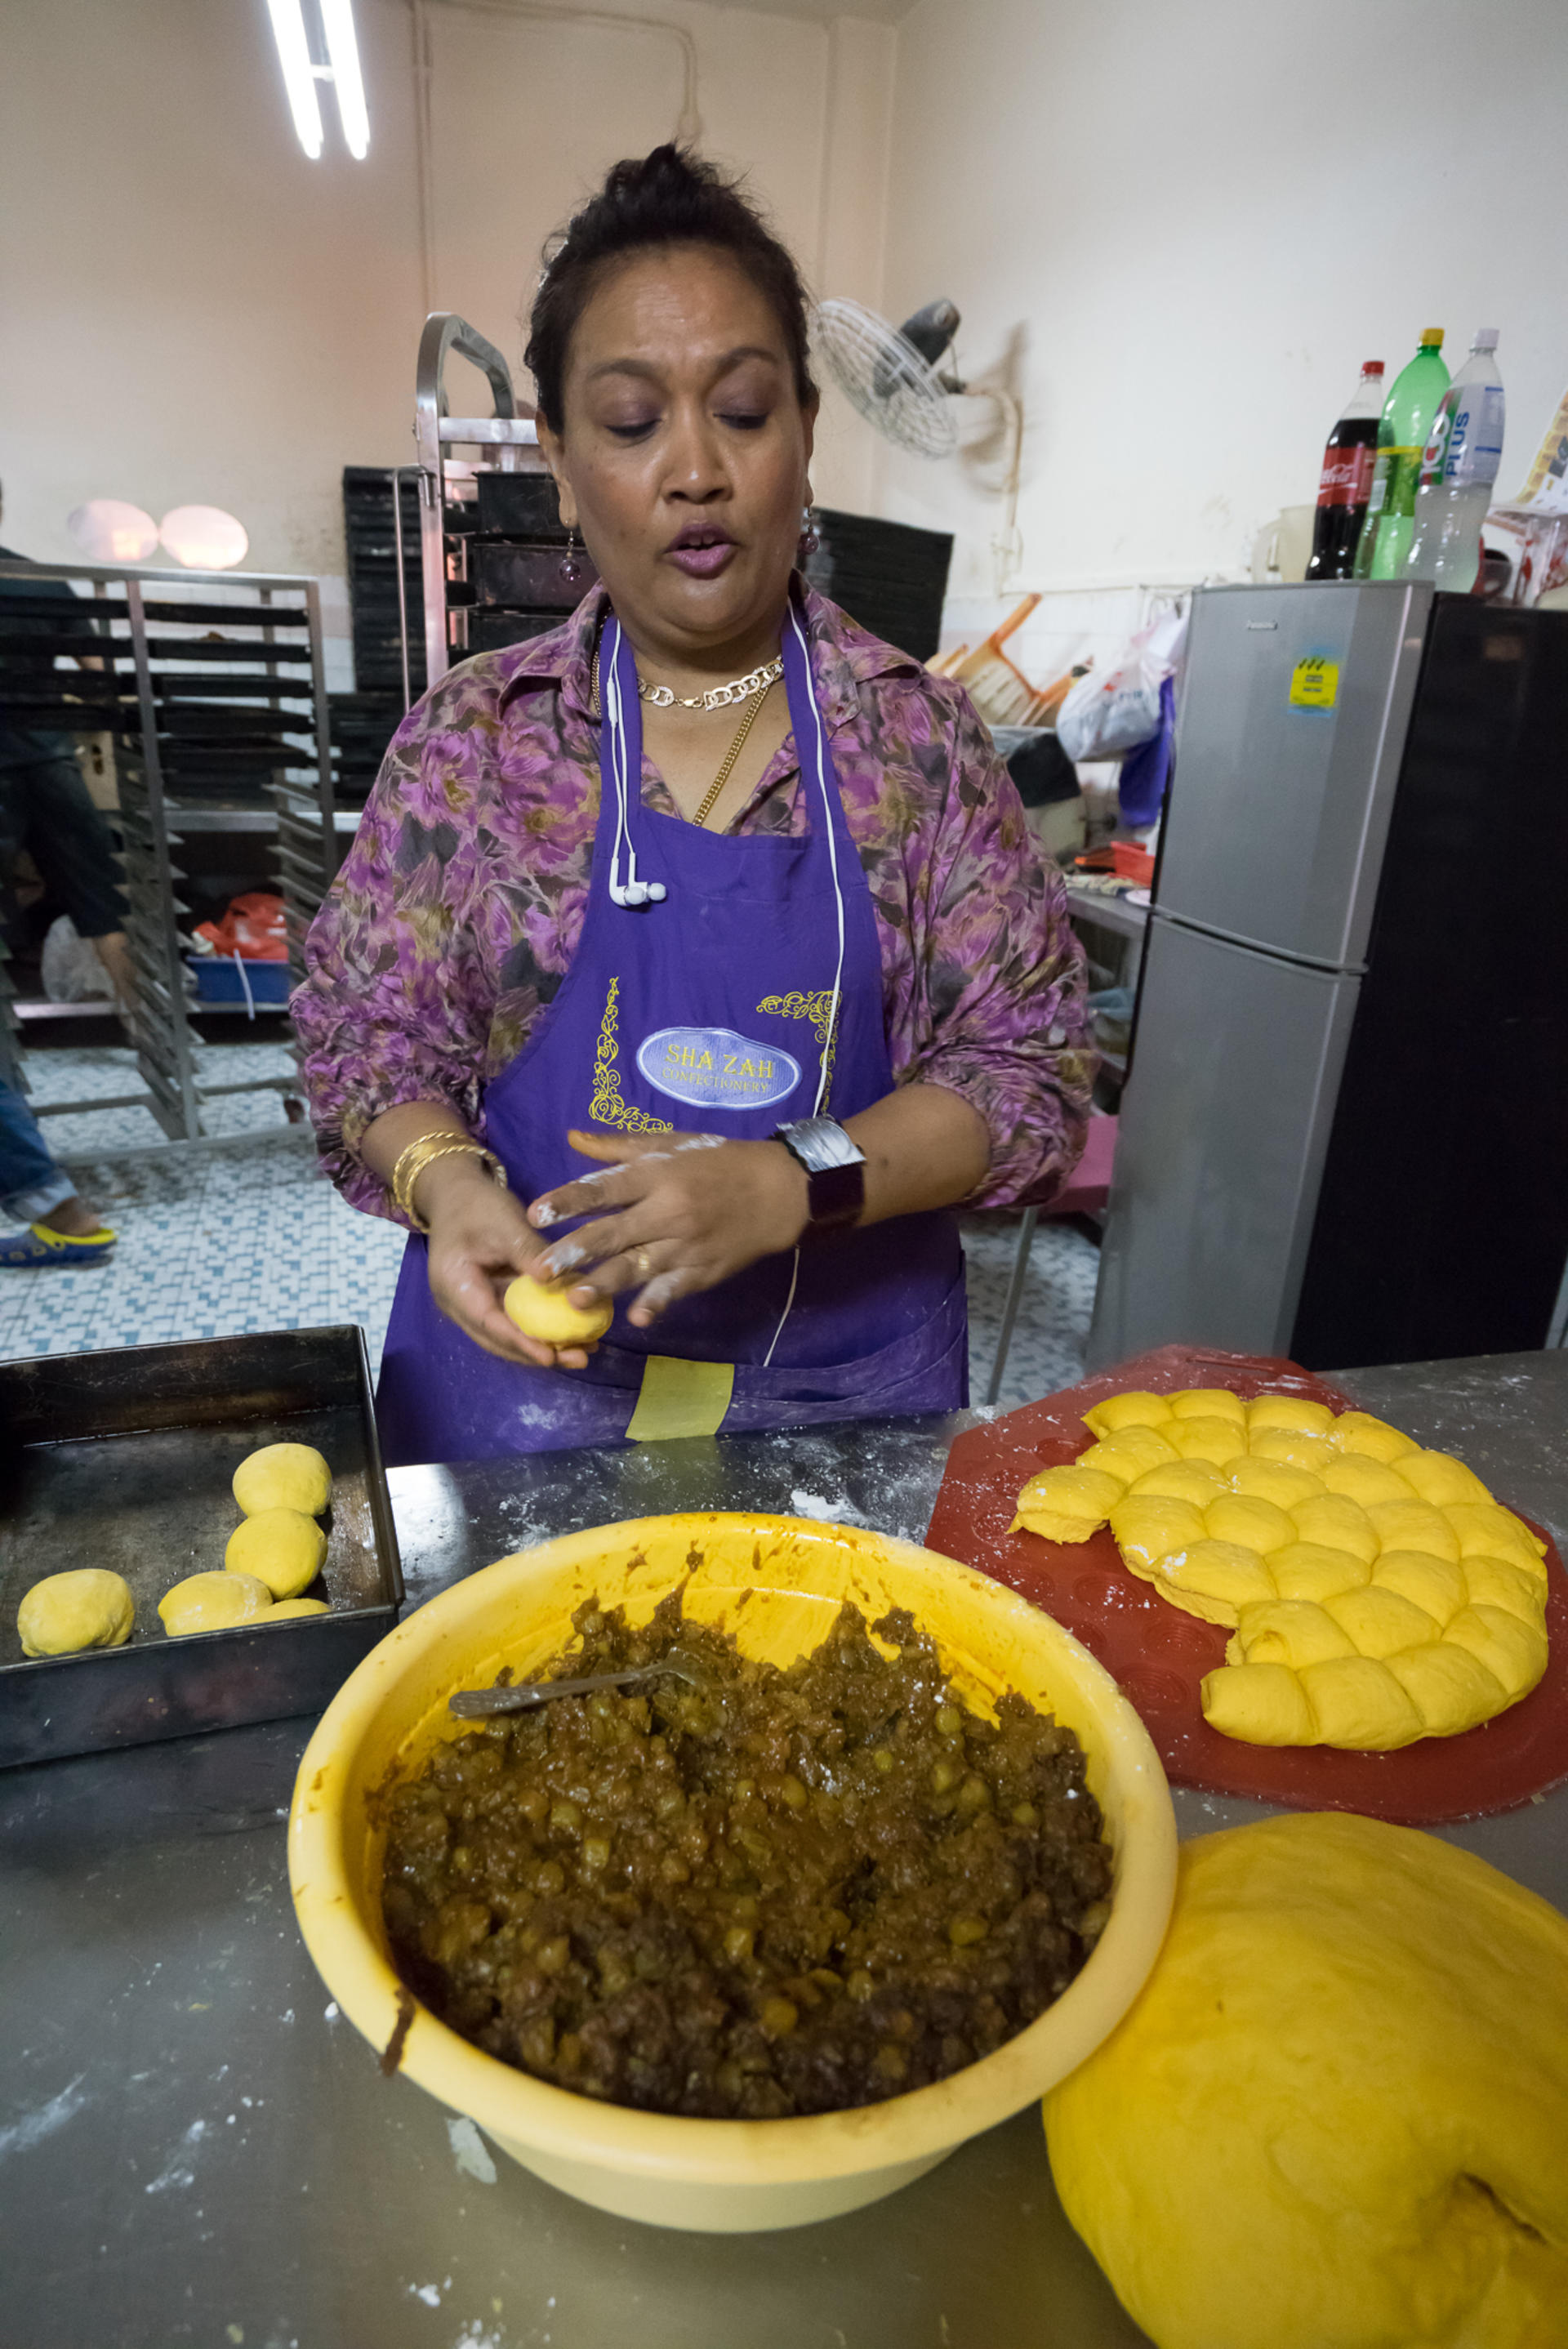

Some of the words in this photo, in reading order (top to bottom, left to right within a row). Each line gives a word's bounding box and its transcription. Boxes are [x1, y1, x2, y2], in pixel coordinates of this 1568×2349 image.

[1446, 412, 1469, 476] PLUS
[664, 1044, 713, 1071] SHA
[723, 1054, 773, 1078] ZAH
[662, 1068, 769, 1093] CONFECTIONERY
